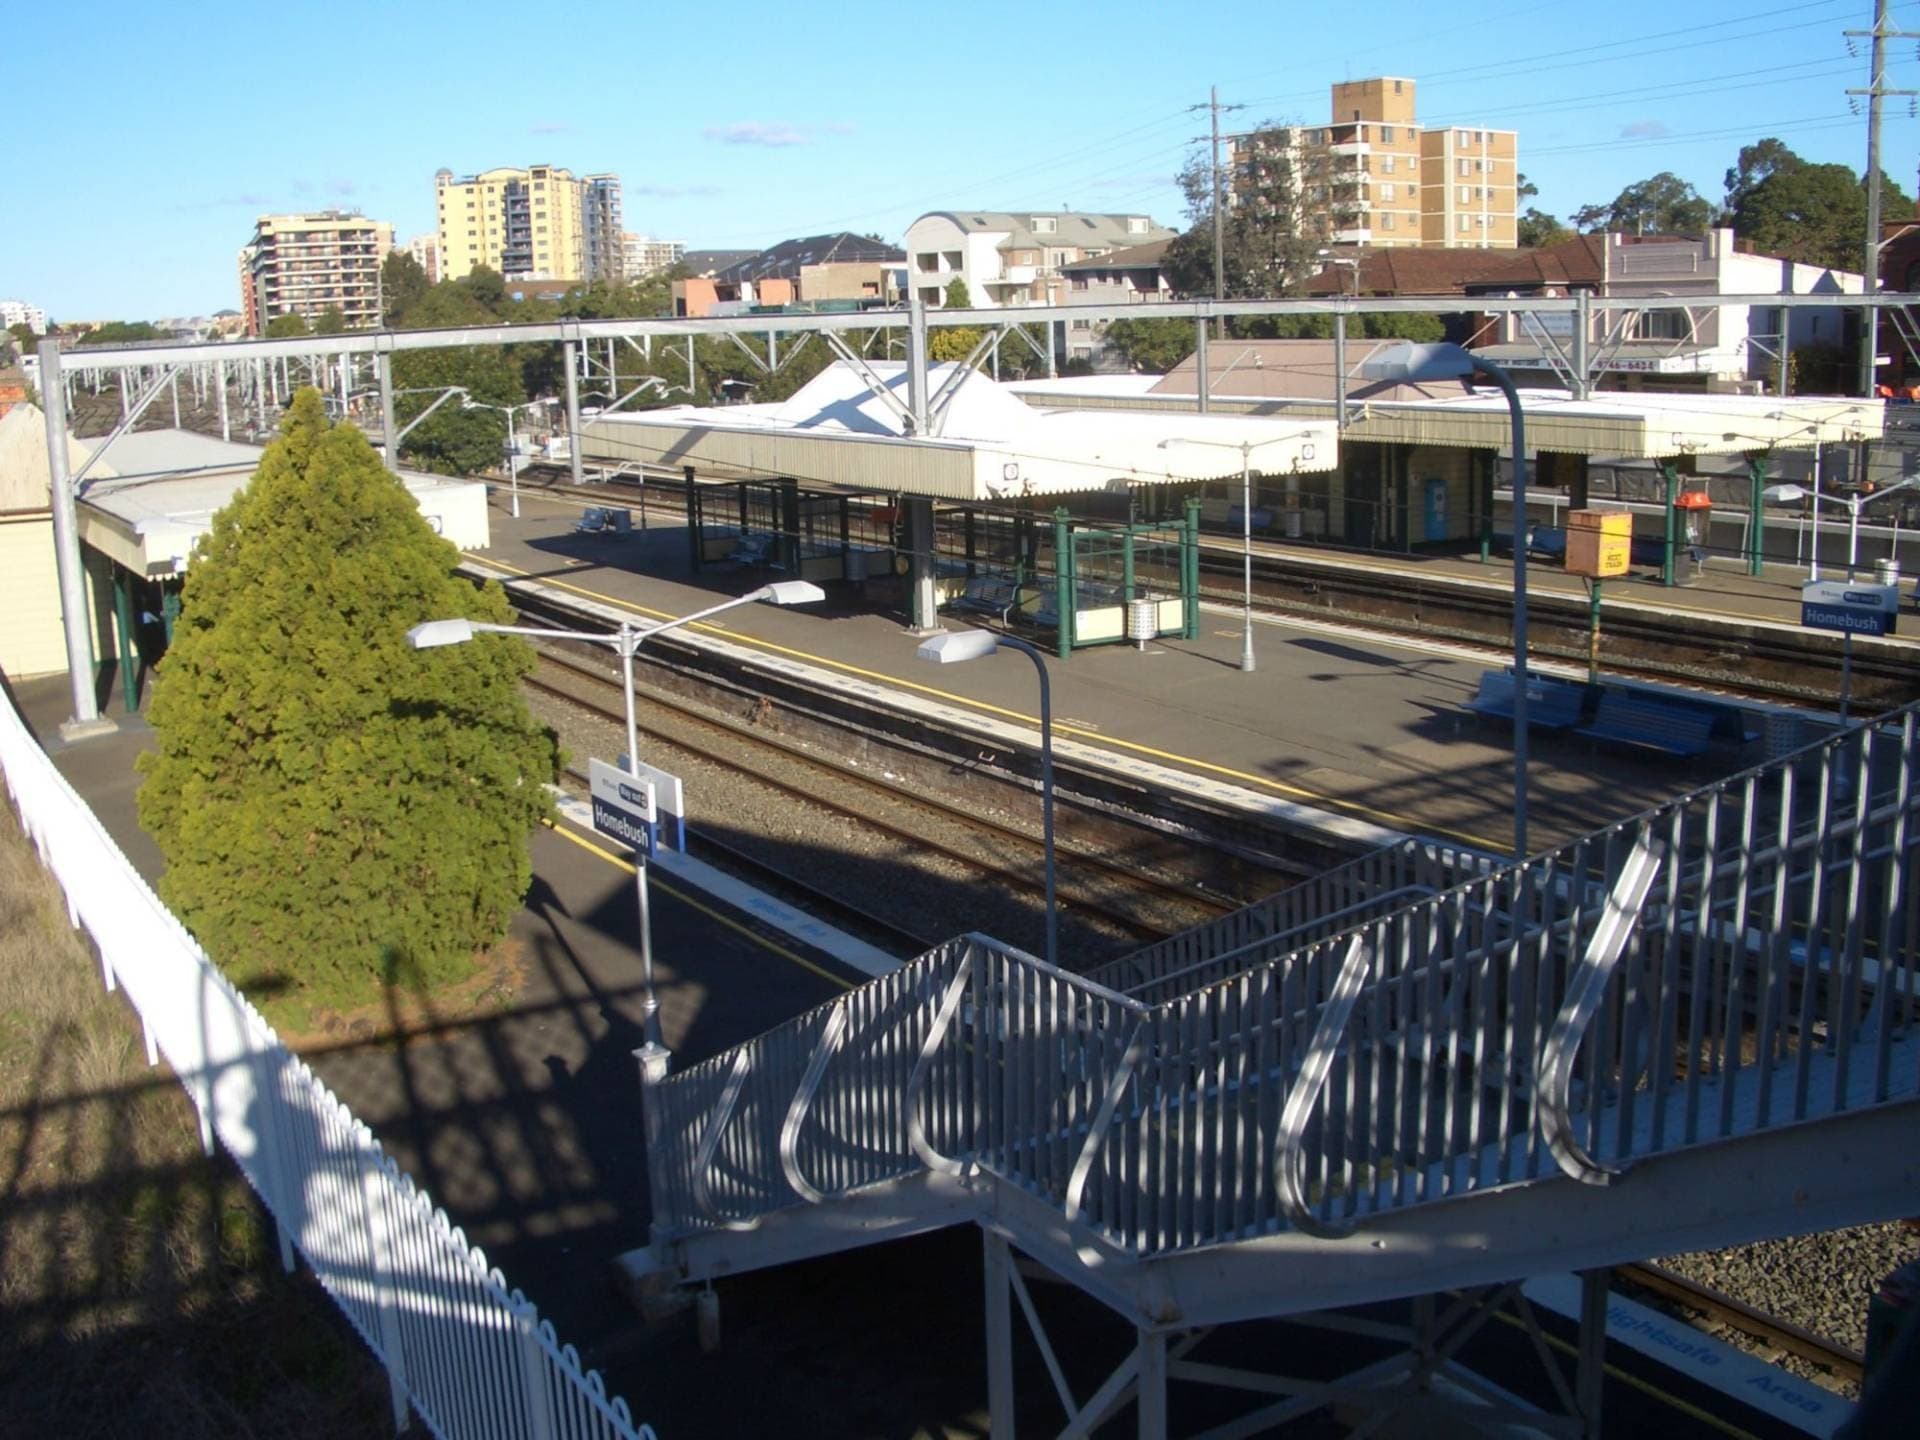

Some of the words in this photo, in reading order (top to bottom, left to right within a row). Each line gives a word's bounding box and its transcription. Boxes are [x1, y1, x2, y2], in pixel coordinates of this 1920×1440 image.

[1806, 608, 1879, 632] Homebush
[595, 803, 649, 849] Homebush
[1745, 1375, 1823, 1413] Area
